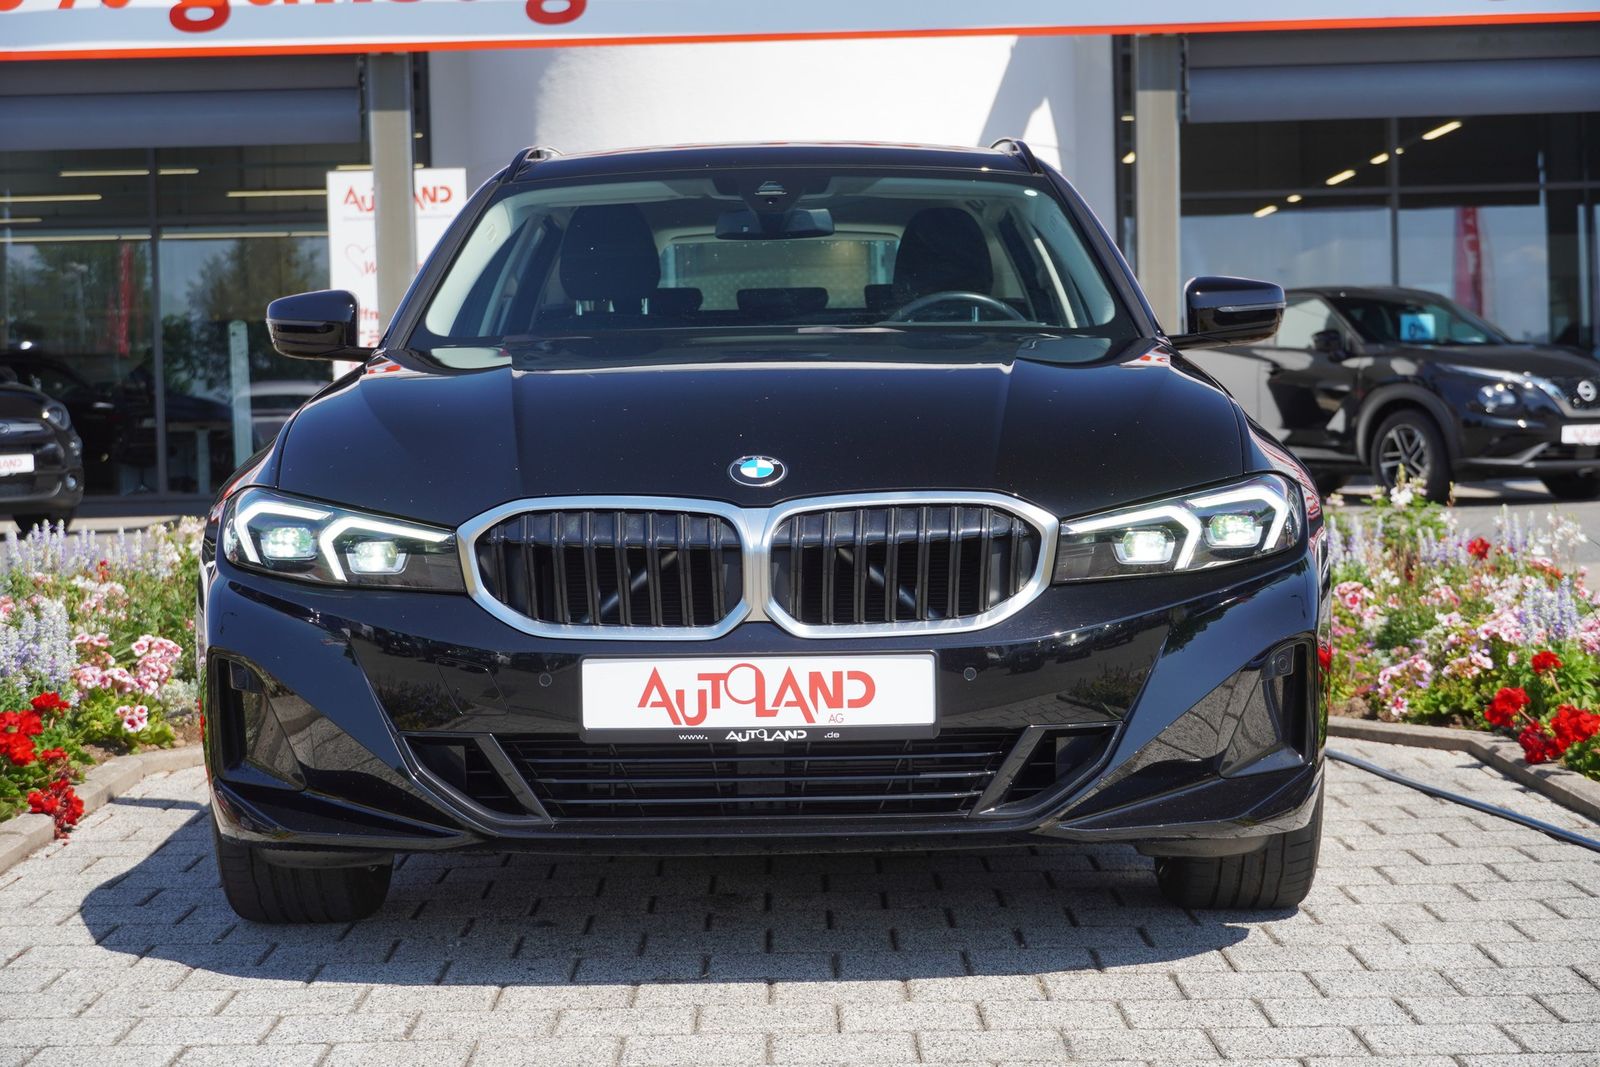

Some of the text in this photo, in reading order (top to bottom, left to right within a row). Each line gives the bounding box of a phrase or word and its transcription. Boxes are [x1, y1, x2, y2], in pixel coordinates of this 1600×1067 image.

[637, 663, 876, 726] AUTOLAND
[828, 713, 845, 724] AG
[678, 733, 709, 741] www.
[725, 728, 808, 742] AUTOLAND
